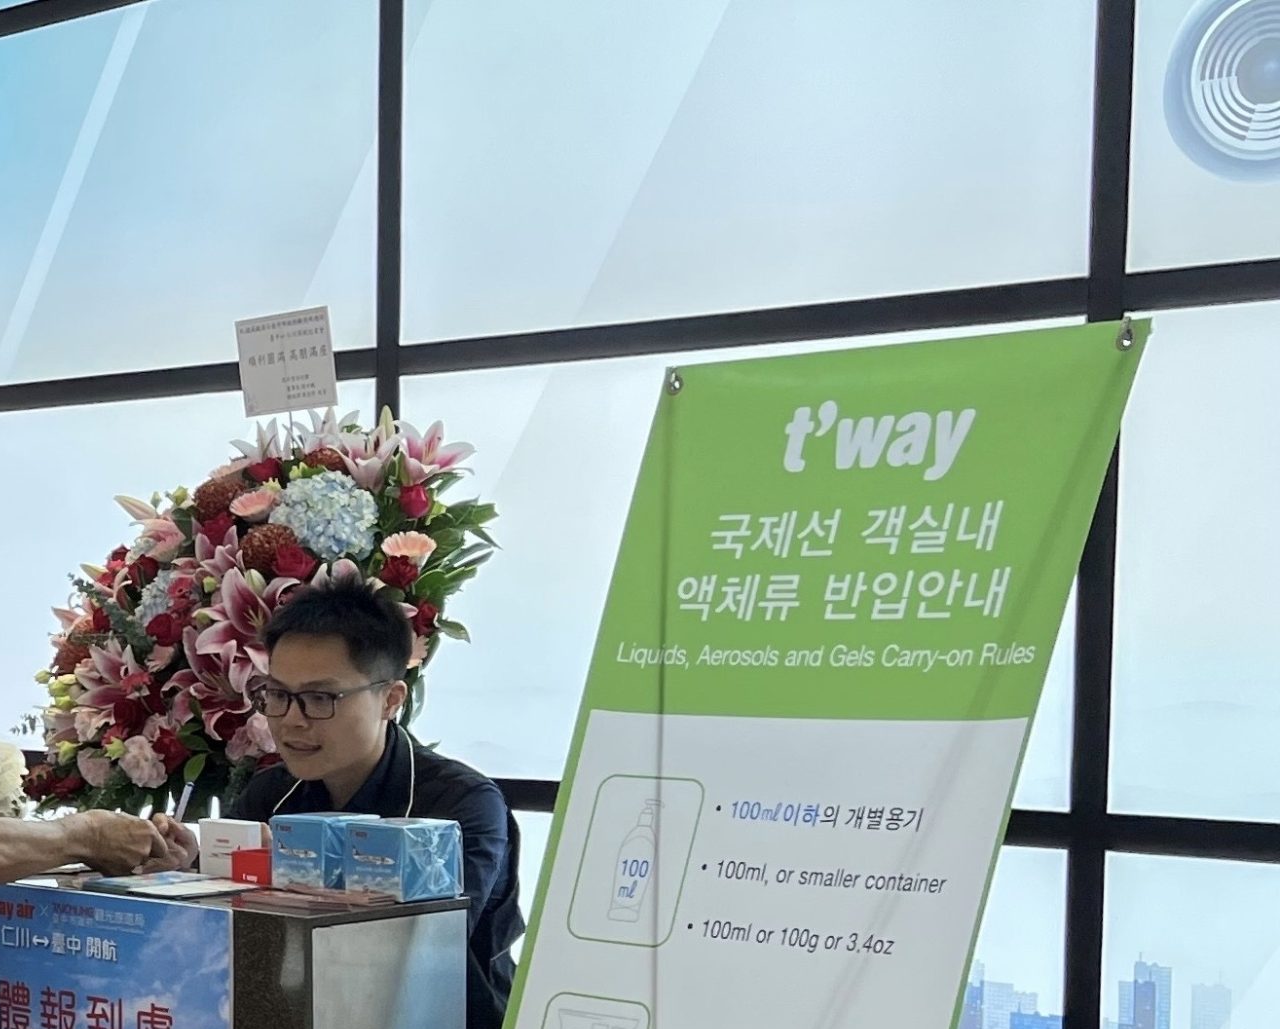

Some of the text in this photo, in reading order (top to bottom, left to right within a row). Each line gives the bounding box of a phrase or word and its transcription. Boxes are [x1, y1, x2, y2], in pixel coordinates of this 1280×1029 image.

[783, 400, 977, 481] t'way
[709, 500, 1004, 559] 국제선 객실내
[677, 567, 1012, 621] 액체류 반입안내
[616, 641, 1036, 673] Liquids, Aerosols and Gels Carry-on Rules
[844, 805, 925, 832] 개별용기
[622, 859, 649, 878] 100
[717, 860, 947, 894] 100ml, or smaller container
[16, 898, 36, 920] air
[86, 936, 117, 962] 開航
[701, 919, 895, 955] 100ml or 100g or 3.4oz
